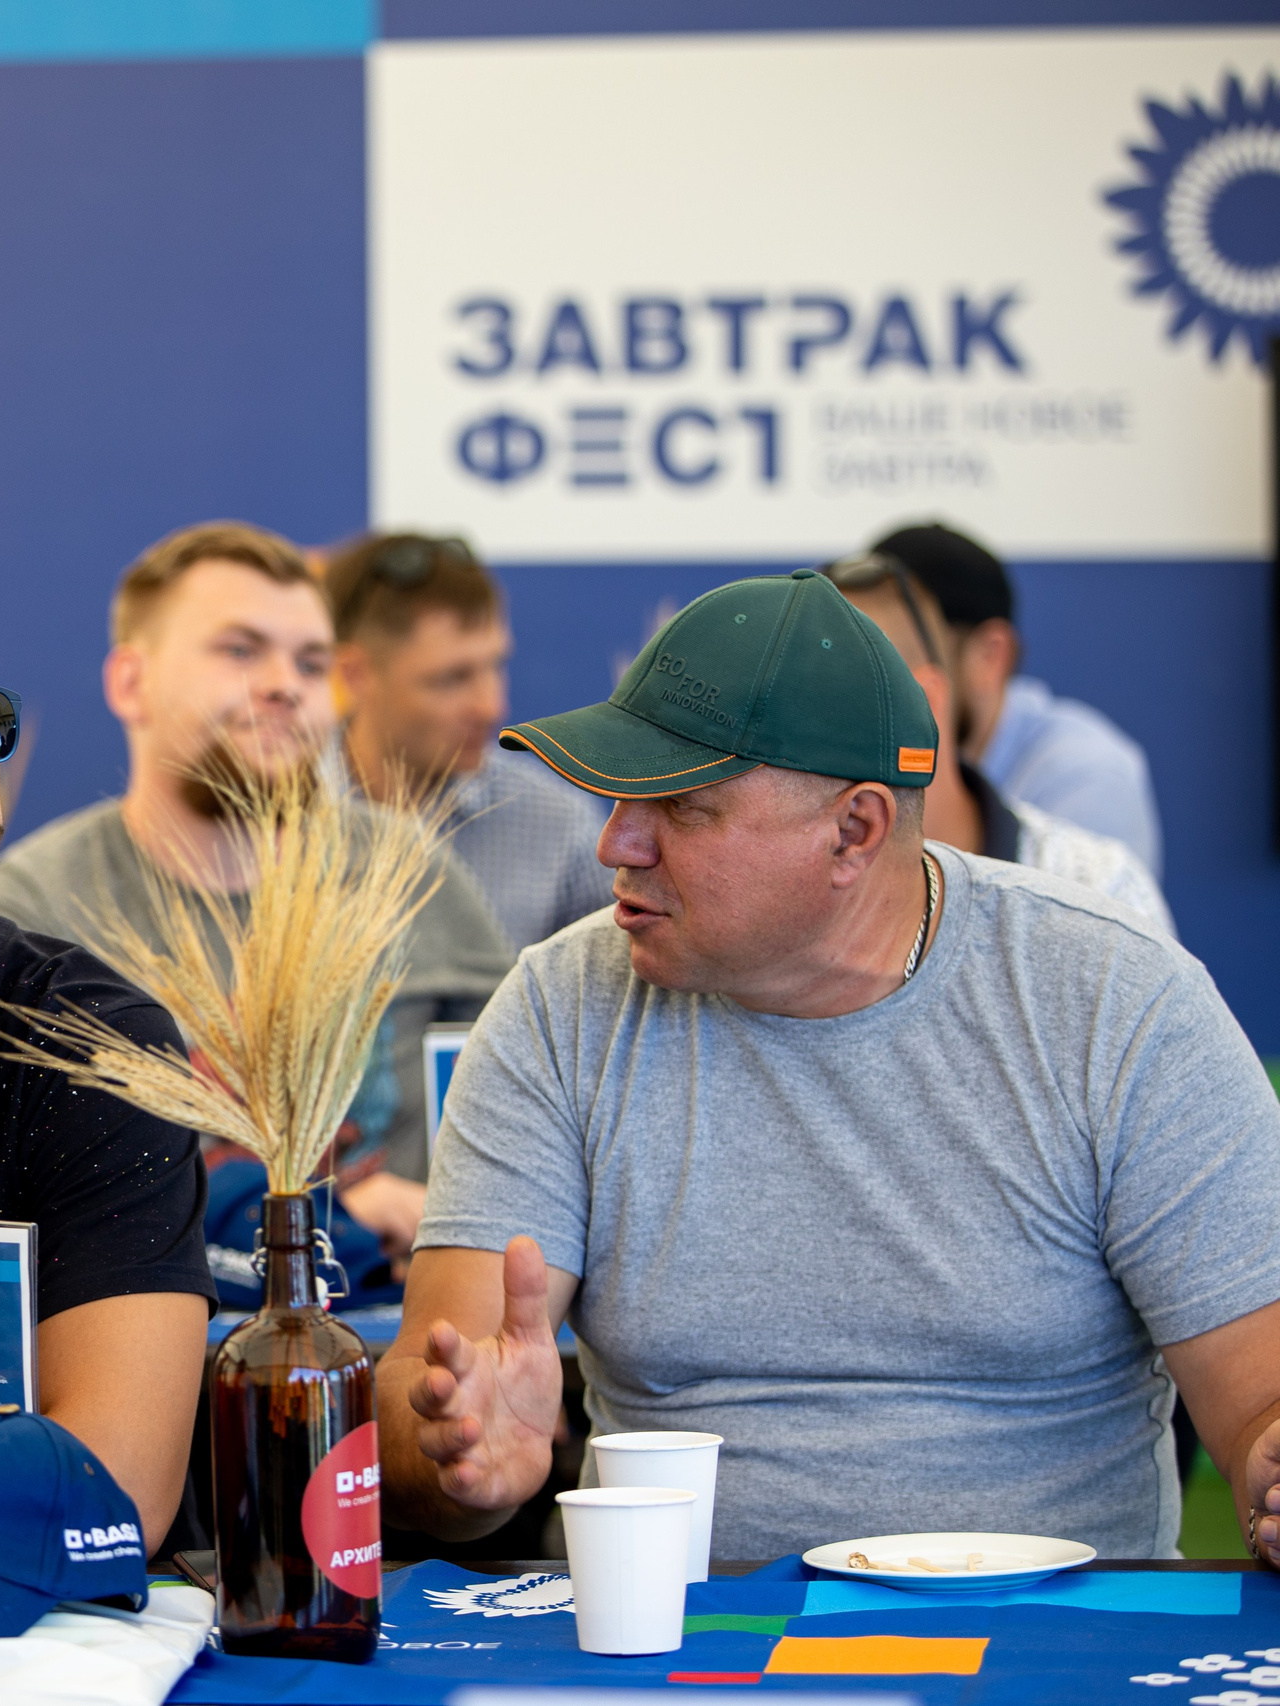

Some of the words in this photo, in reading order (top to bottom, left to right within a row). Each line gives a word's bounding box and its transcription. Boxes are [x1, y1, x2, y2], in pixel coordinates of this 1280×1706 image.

[453, 292, 1031, 377] ЗАВТРАК
[454, 405, 782, 487] ФЕСТ
[655, 652, 687, 677] GO
[676, 674, 721, 705] FOR
[660, 687, 739, 729] INNOVATION
[377, 1641, 503, 1650] ОВОЕ
